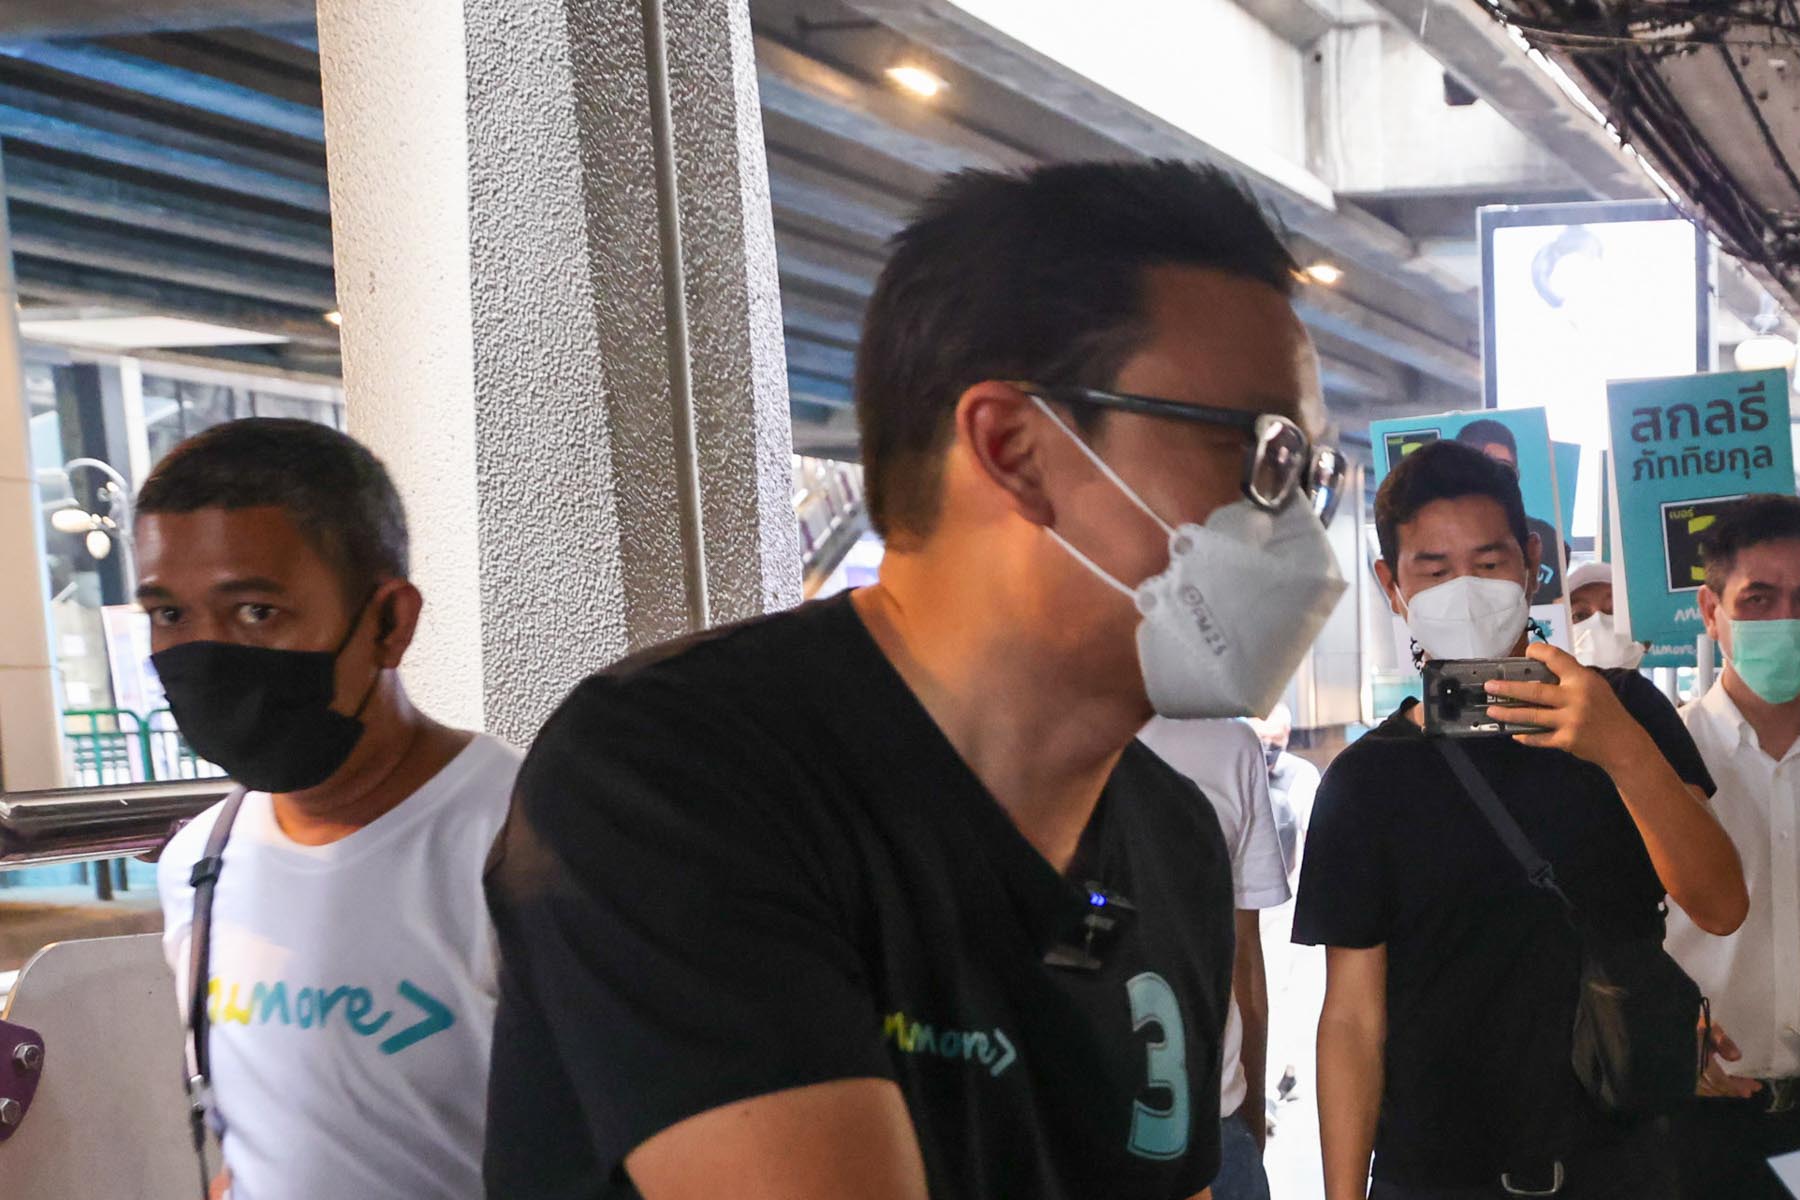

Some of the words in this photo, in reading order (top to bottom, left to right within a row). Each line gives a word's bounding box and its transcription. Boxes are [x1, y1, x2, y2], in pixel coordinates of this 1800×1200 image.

[1631, 380, 1769, 443] สกลธี
[1633, 444, 1774, 481] ภัททิยกุล
[1126, 971, 1191, 1161] 3
